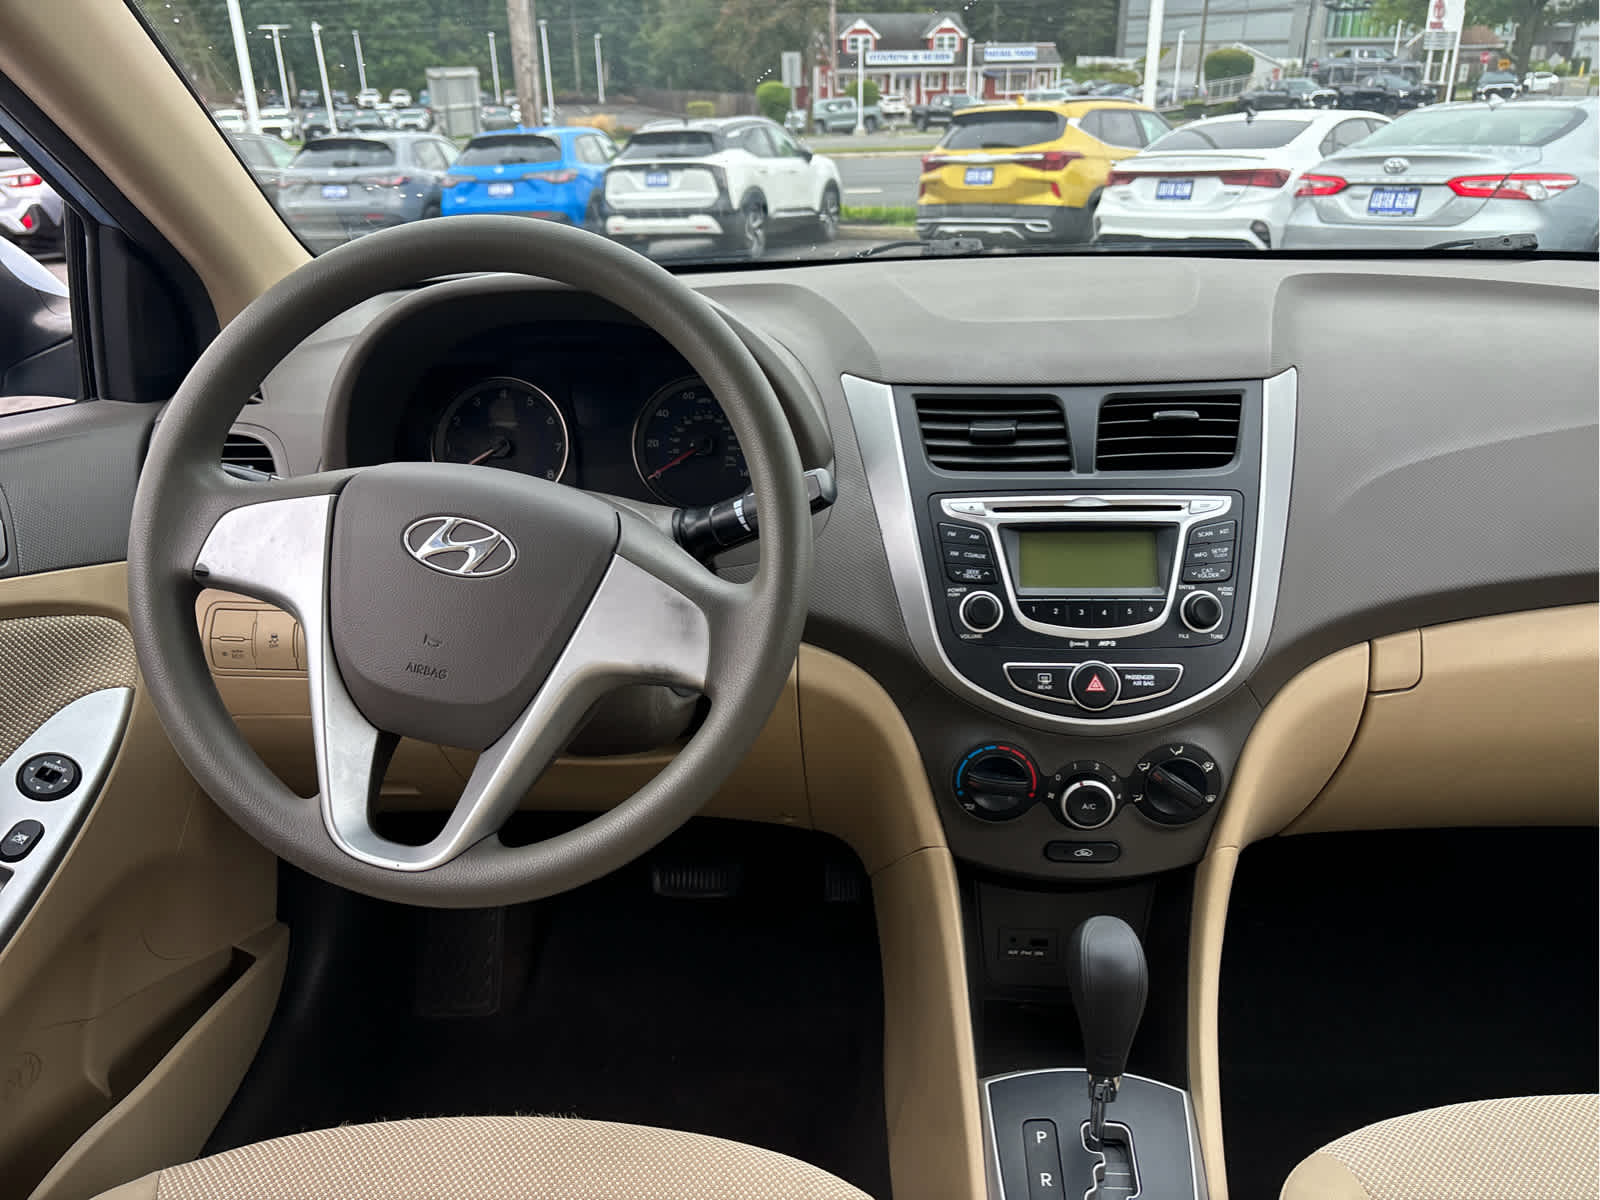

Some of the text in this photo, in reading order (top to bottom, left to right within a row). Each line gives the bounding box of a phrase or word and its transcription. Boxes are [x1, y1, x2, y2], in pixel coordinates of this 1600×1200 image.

[682, 391, 696, 401] 60
[656, 408, 670, 418] 40
[647, 438, 660, 449] 20
[405, 661, 449, 680] AIRBAG
[1094, 762, 1100, 771] 2
[1111, 774, 1117, 783] 3
[1081, 802, 1097, 810] A/C
[1036, 1131, 1047, 1144] P
[1040, 1173, 1052, 1187] R
